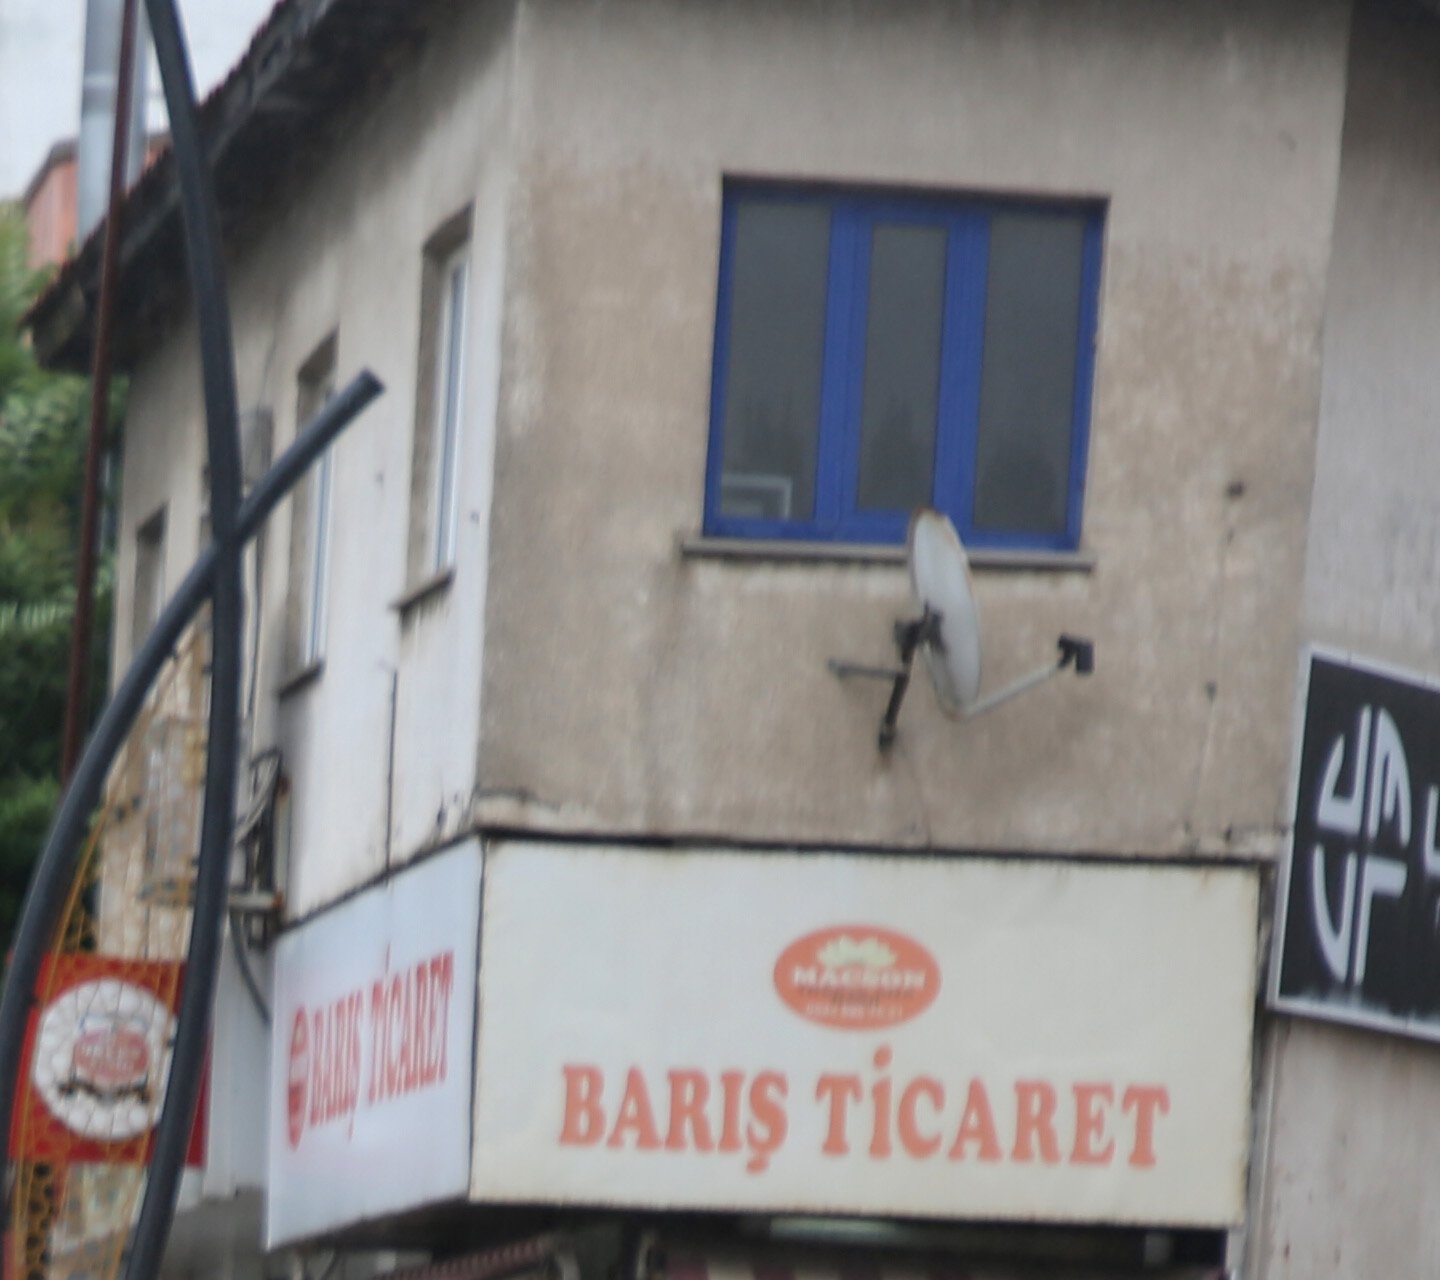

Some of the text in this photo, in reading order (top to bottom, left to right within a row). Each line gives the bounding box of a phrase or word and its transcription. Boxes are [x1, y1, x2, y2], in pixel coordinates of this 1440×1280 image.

[368, 942, 454, 1106] TİCARET
[559, 1046, 1170, 1174] BARIŞ TİCARET
